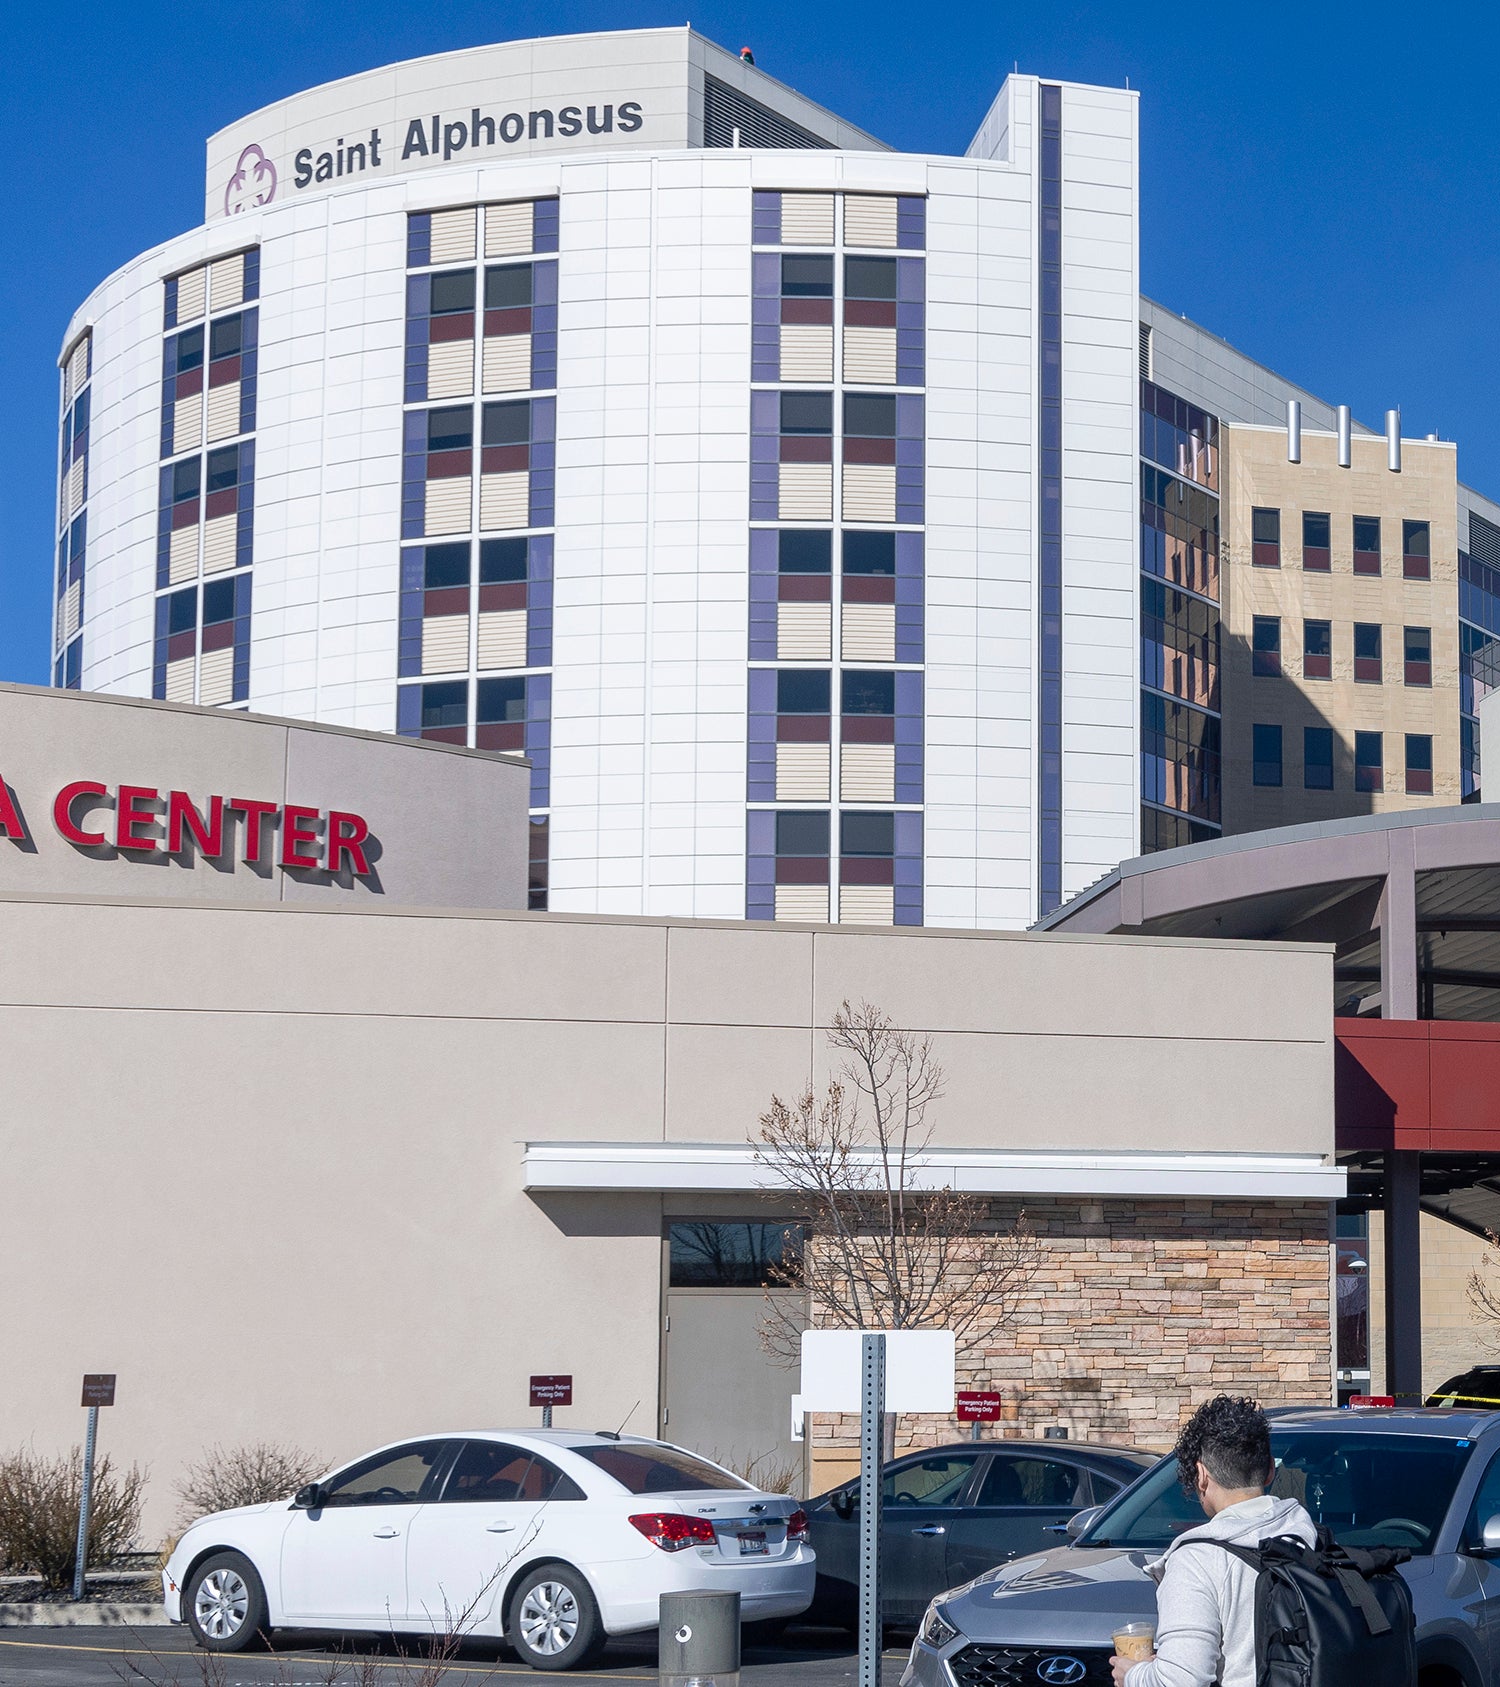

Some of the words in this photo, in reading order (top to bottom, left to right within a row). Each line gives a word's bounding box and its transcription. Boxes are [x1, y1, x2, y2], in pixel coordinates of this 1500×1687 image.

[294, 128, 382, 189] Saint
[401, 101, 644, 160] Alphonsus
[52, 780, 372, 876] CENTER
